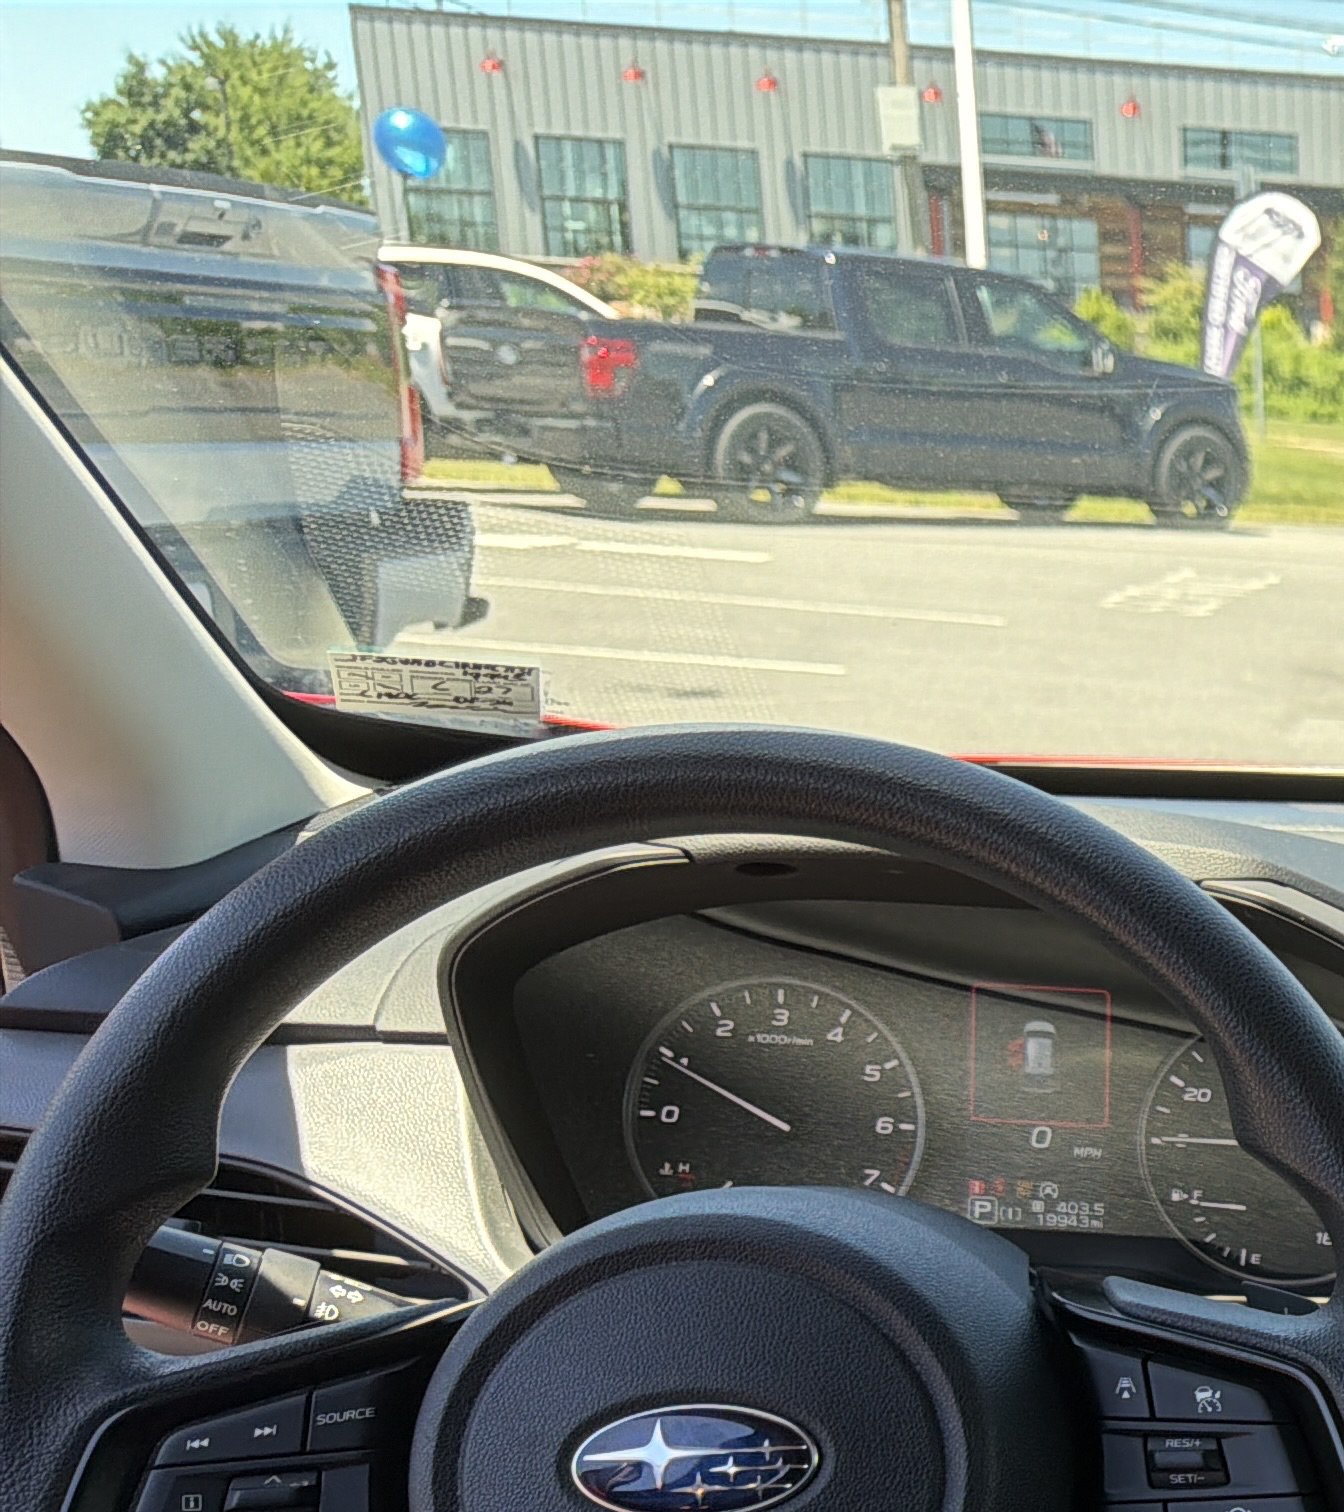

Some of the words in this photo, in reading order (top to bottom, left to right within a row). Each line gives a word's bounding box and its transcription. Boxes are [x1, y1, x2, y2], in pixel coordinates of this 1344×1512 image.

[771, 1008, 790, 1027] 3
[715, 1019, 735, 1037] 2
[826, 1026, 844, 1043] 4
[863, 1064, 882, 1082] 5
[1183, 1088, 1212, 1103] 20
[660, 1105, 680, 1123] 0
[875, 1117, 895, 1135] 6
[1031, 1126, 1052, 1149] 0
[1073, 1147, 1102, 1160] MPH
[678, 1163, 690, 1173] H
[863, 1169, 881, 1186] 7
[1193, 1189, 1203, 1199] F
[1056, 1202, 1105, 1216] 403.5
[1250, 1254, 1261, 1264] E
[203, 1299, 238, 1316] AUTO
[196, 1320, 230, 1336] OFF
[316, 1407, 376, 1425] SOURCE
